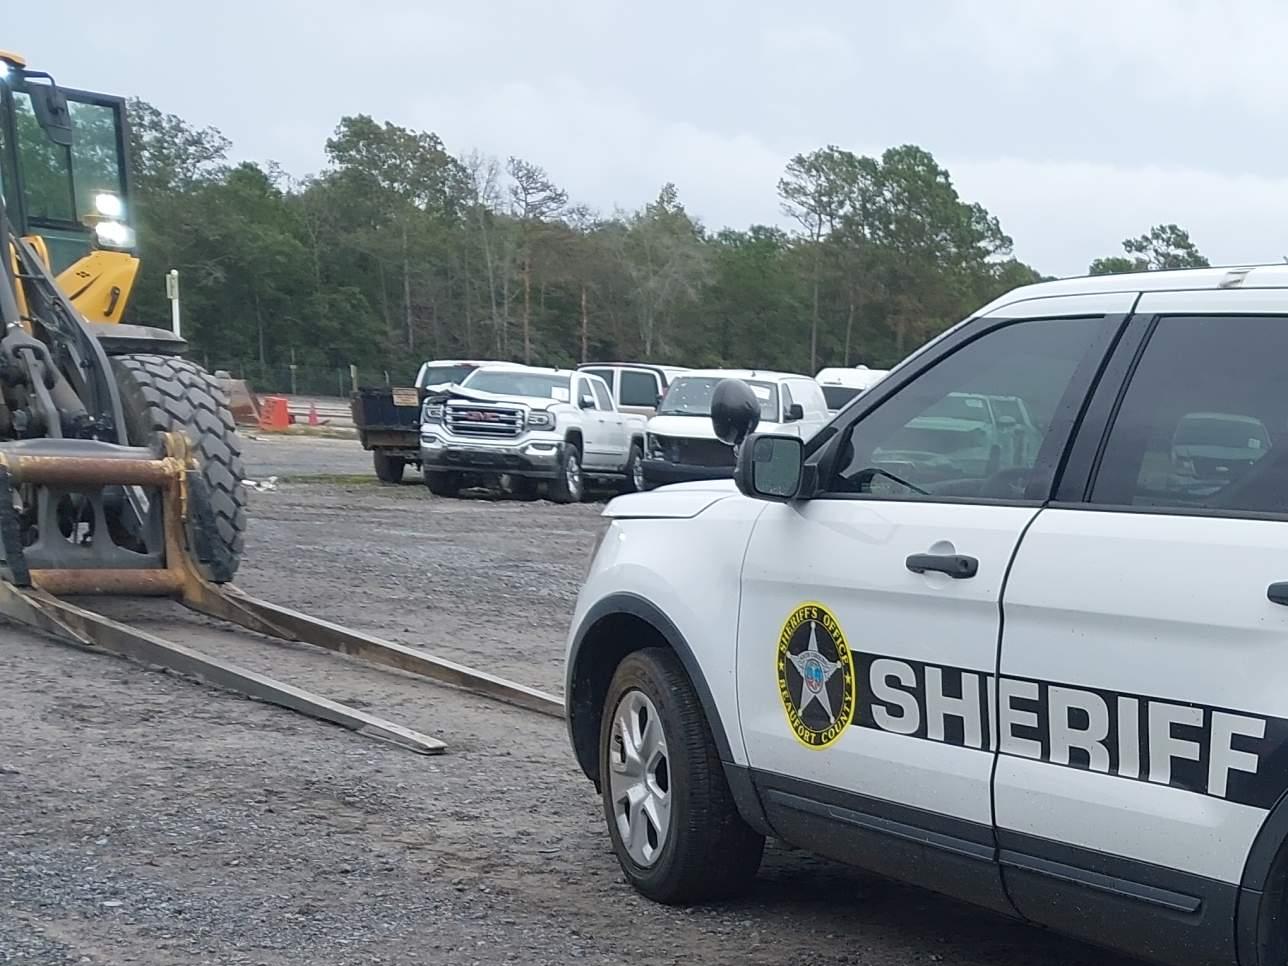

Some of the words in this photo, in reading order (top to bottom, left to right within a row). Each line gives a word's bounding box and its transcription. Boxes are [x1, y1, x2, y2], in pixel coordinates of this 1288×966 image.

[822, 613, 850, 665] OFFICE
[779, 679, 817, 744] BEAUFORT
[821, 691, 852, 744] COUNTY
[869, 658, 1267, 798] SHERIFF
